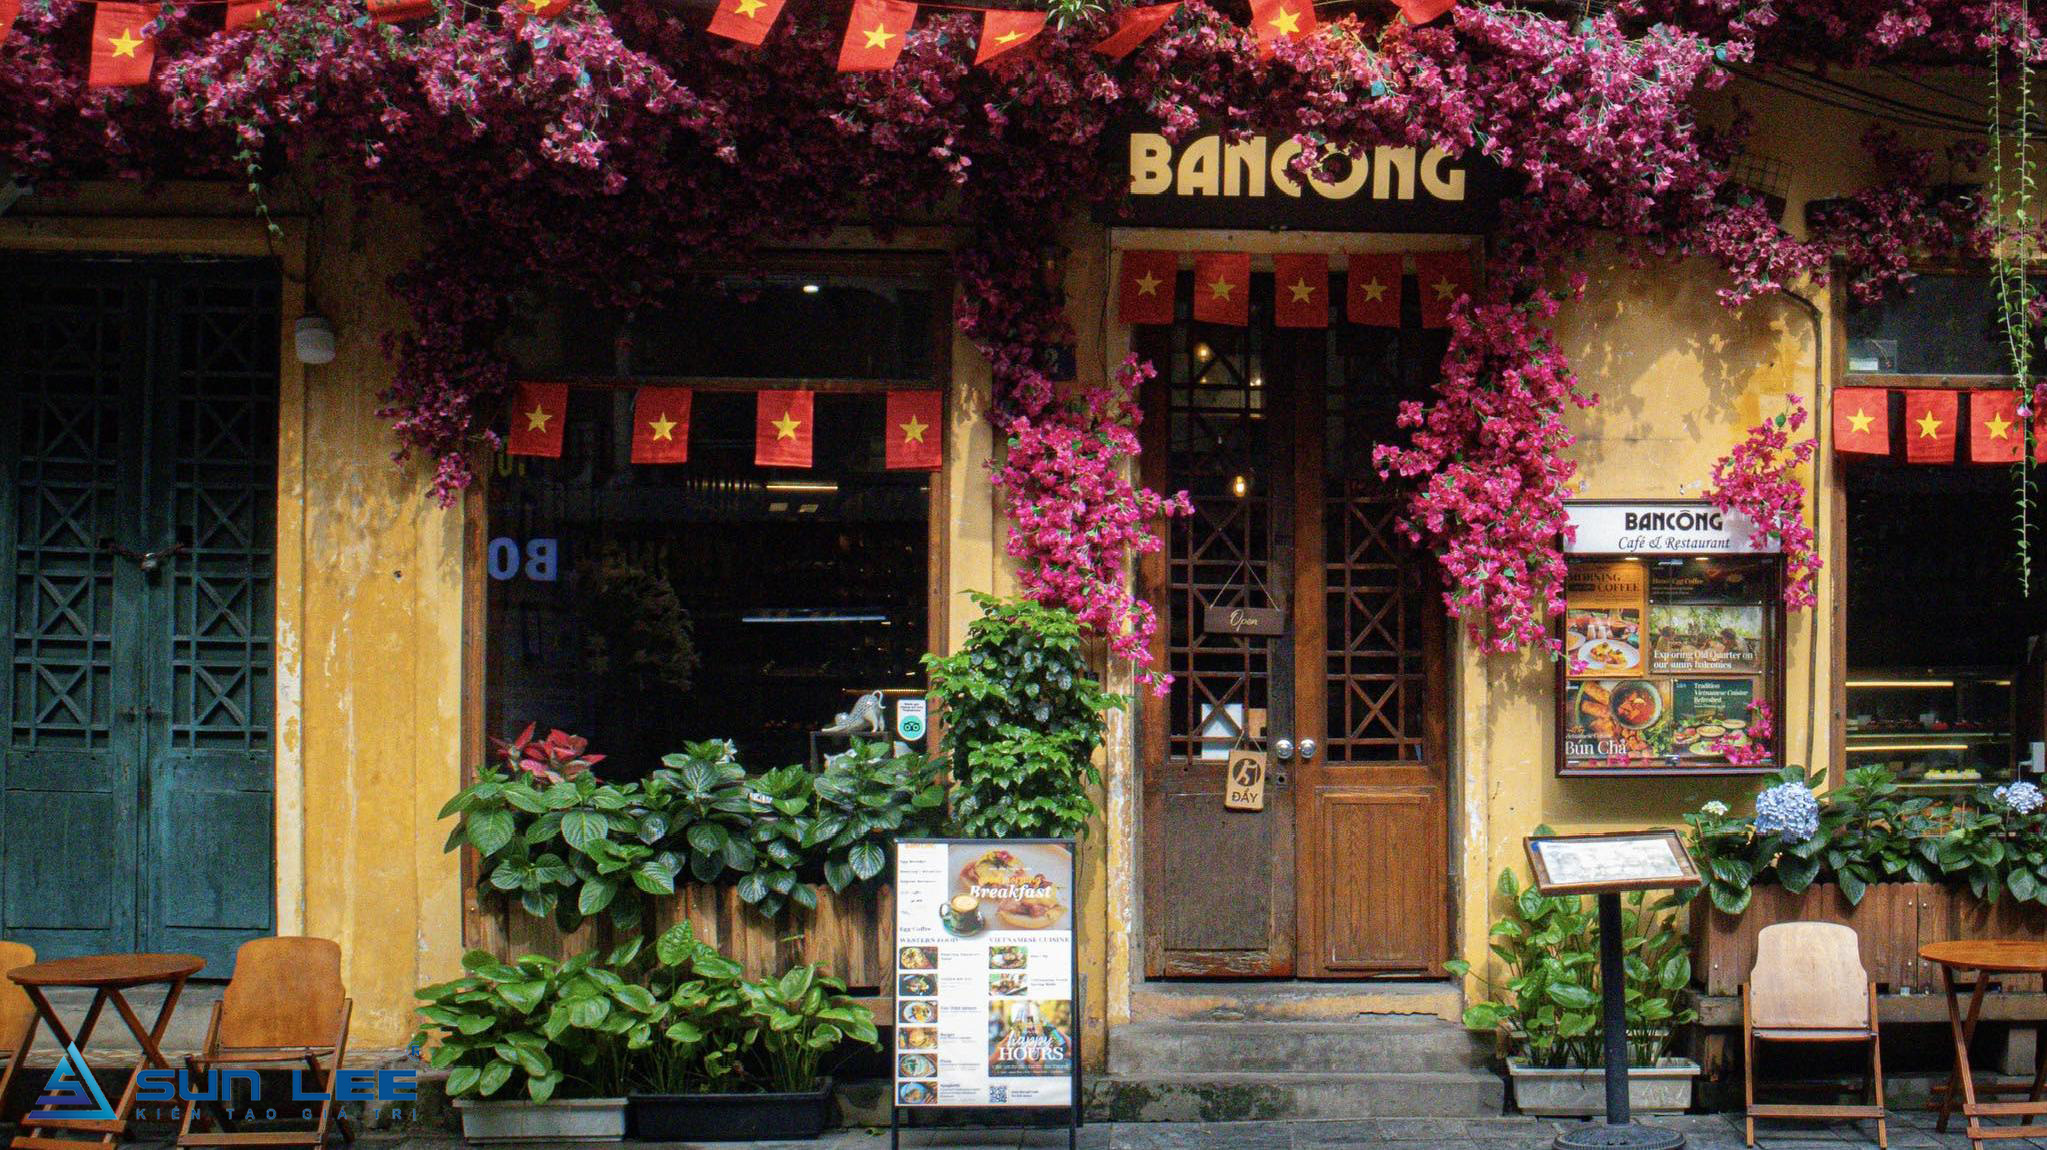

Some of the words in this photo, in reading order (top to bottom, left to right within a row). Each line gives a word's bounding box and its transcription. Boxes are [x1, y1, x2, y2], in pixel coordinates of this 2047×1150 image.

[1625, 510, 1723, 531] BANCÔNG
[1618, 536, 1646, 552] Café
[1649, 535, 1662, 549] &
[1665, 537, 1730, 549] Restaurant
[1597, 584, 1640, 592] COFFEE
[1230, 609, 1258, 632] Open
[1565, 740, 1594, 755] Bún
[970, 884, 1052, 901] Breakfast
[998, 1046, 1064, 1061] HOURS
